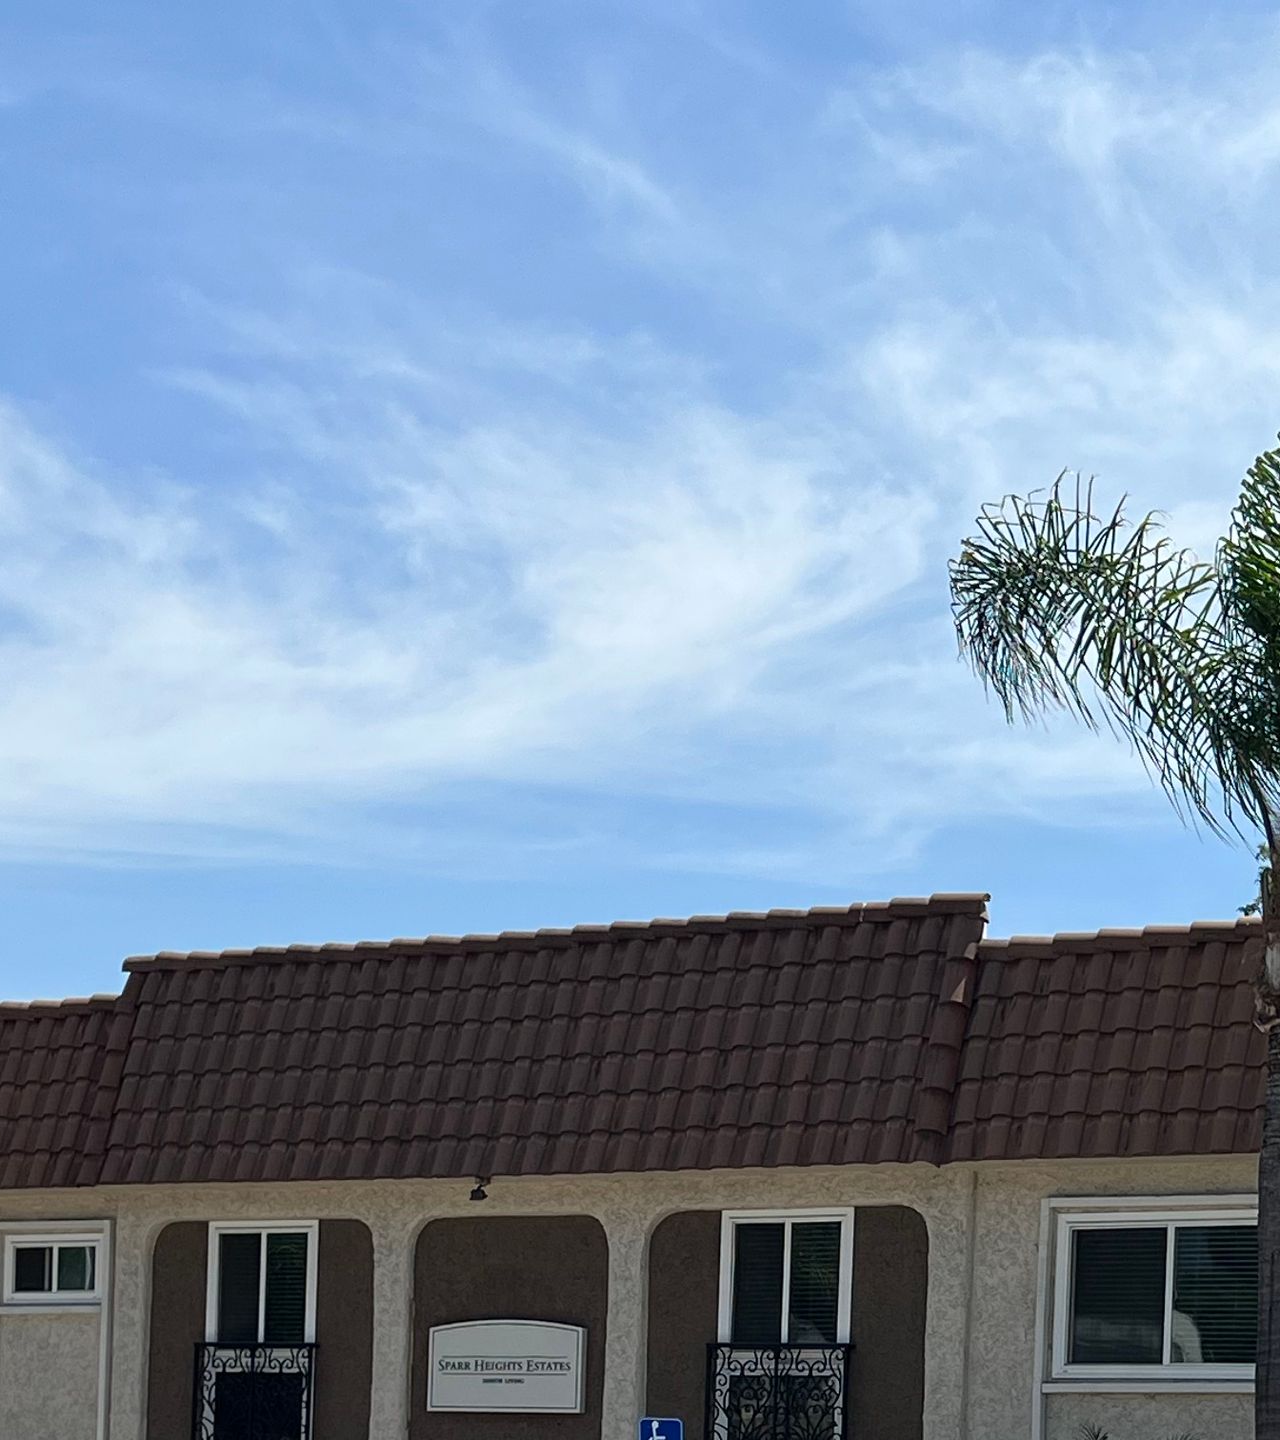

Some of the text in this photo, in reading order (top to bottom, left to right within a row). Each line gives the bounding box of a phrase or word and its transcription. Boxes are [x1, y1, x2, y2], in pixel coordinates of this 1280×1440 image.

[438, 1359, 572, 1372] SPARR HEIGHTS ESTATES
